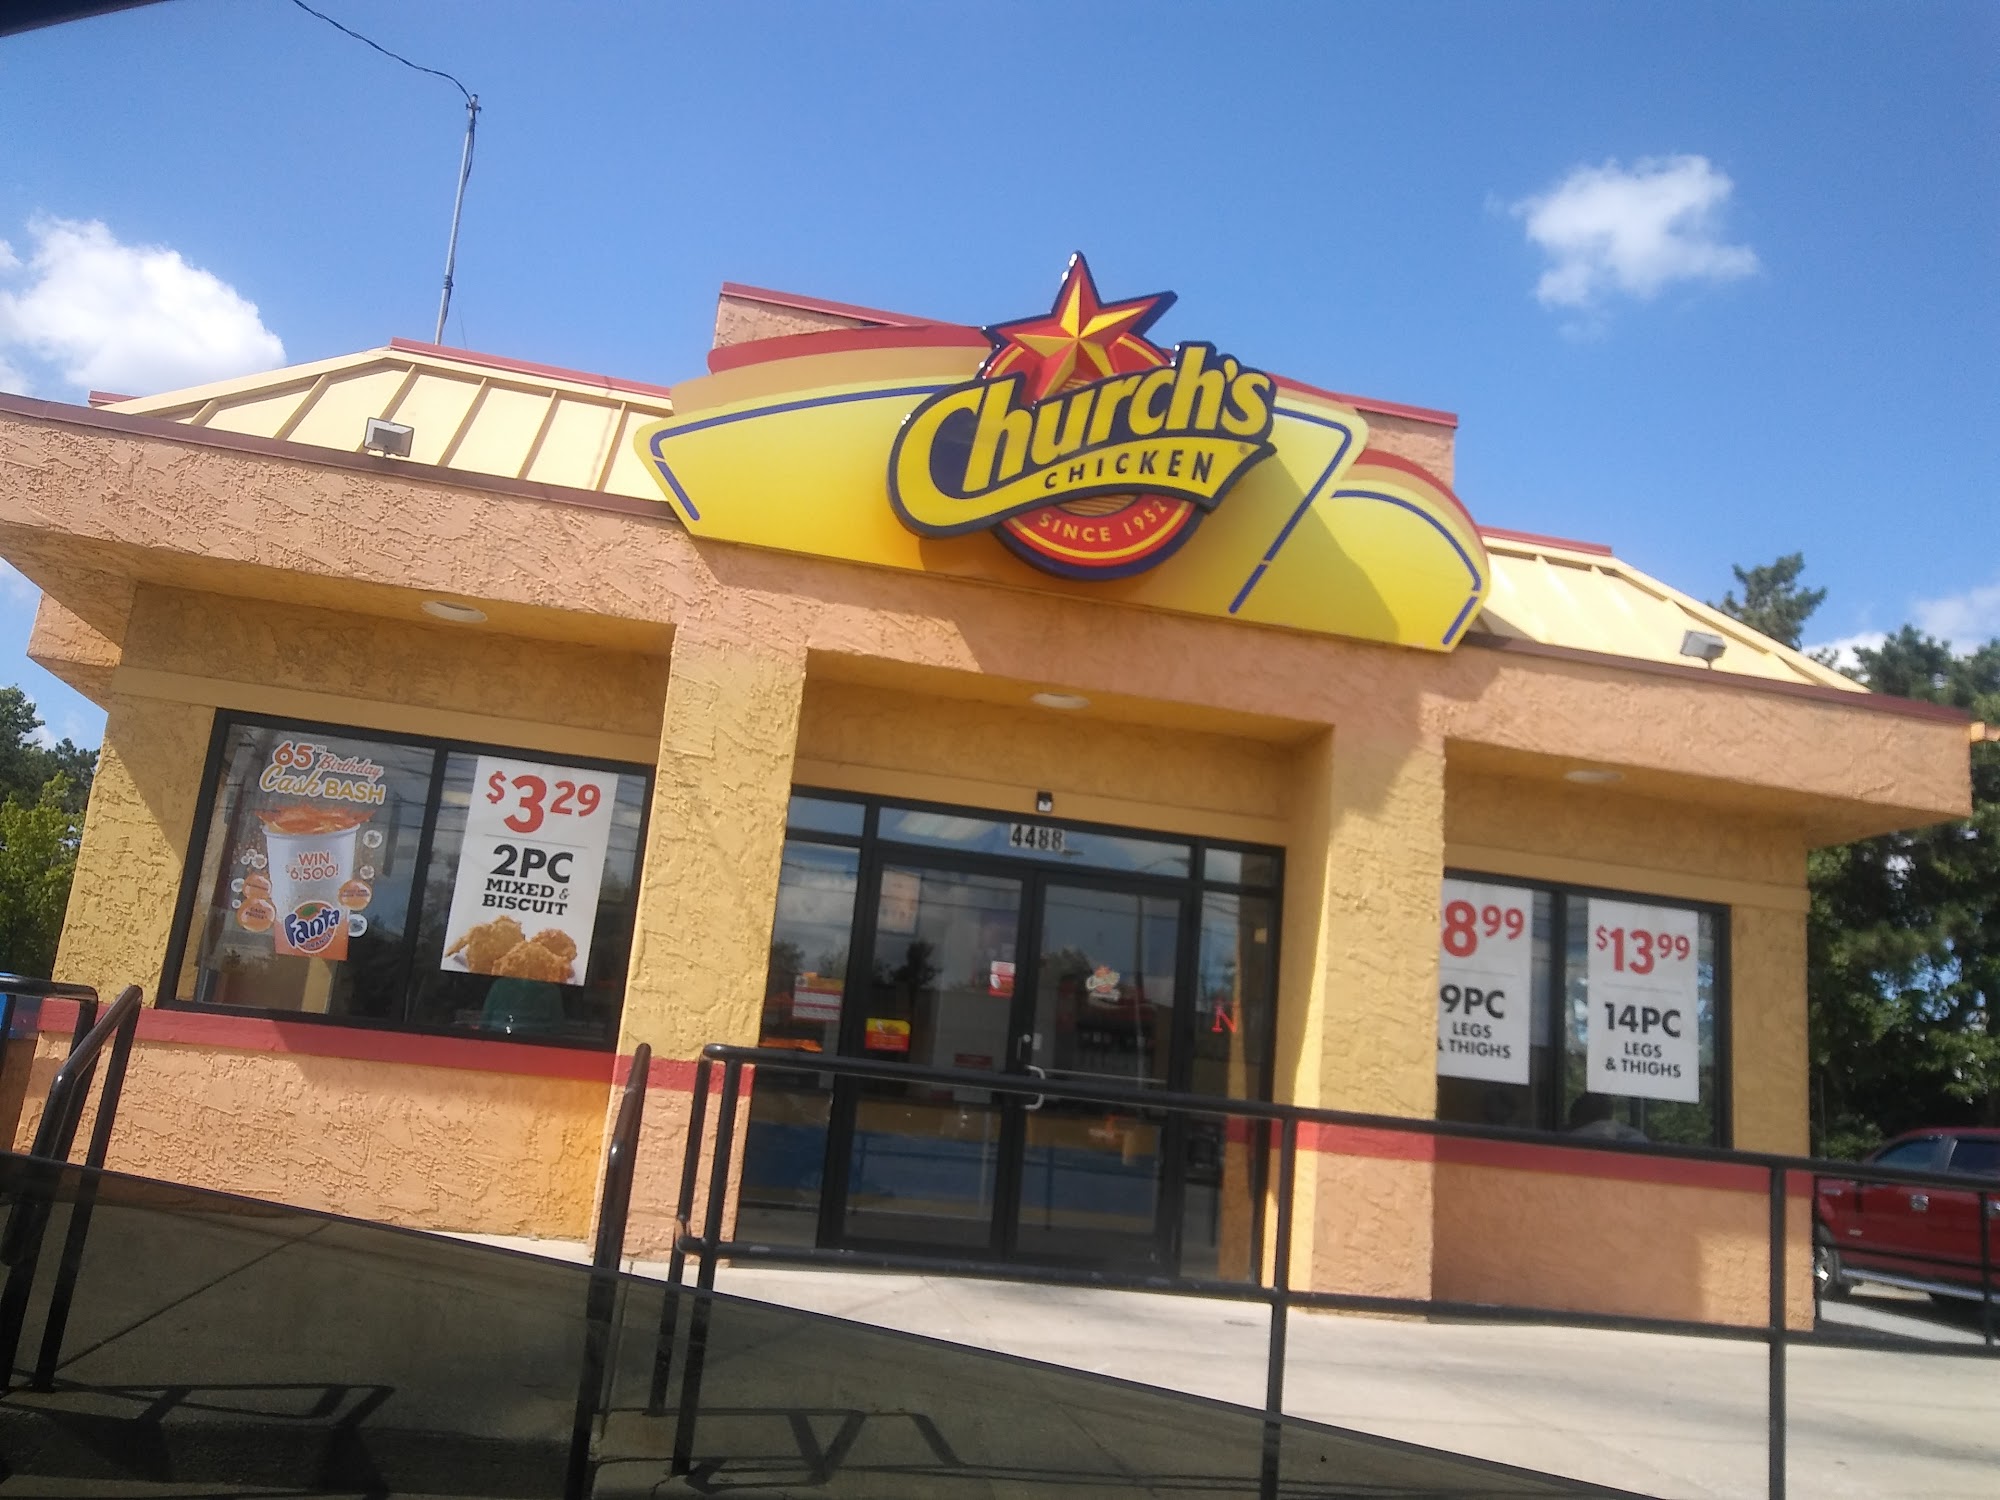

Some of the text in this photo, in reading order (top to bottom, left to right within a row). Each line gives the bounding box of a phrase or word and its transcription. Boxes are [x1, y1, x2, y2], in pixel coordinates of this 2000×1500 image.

[897, 346, 1272, 528] Church's
[1043, 449, 1216, 490] CHICKEN
[1038, 499, 1167, 543] SINCE 1952
[319, 754, 383, 779] Birthday
[260, 765, 385, 802] Cash BASH
[1011, 825, 1063, 850] 4488
[298, 852, 331, 866] WIN
[490, 844, 574, 884] 2PC
[485, 878, 570, 901] MIXED &
[482, 893, 568, 915] BISCUIT
[285, 908, 340, 947] Fanta
[1440, 983, 1505, 1019] 9PC
[1452, 1021, 1492, 1039] LEGS
[1604, 1002, 1681, 1038] 14PC
[1449, 1039, 1511, 1059] THIGHS
[1624, 1041, 1662, 1058] LEGS
[1605, 1057, 1681, 1078] & THIGHS
